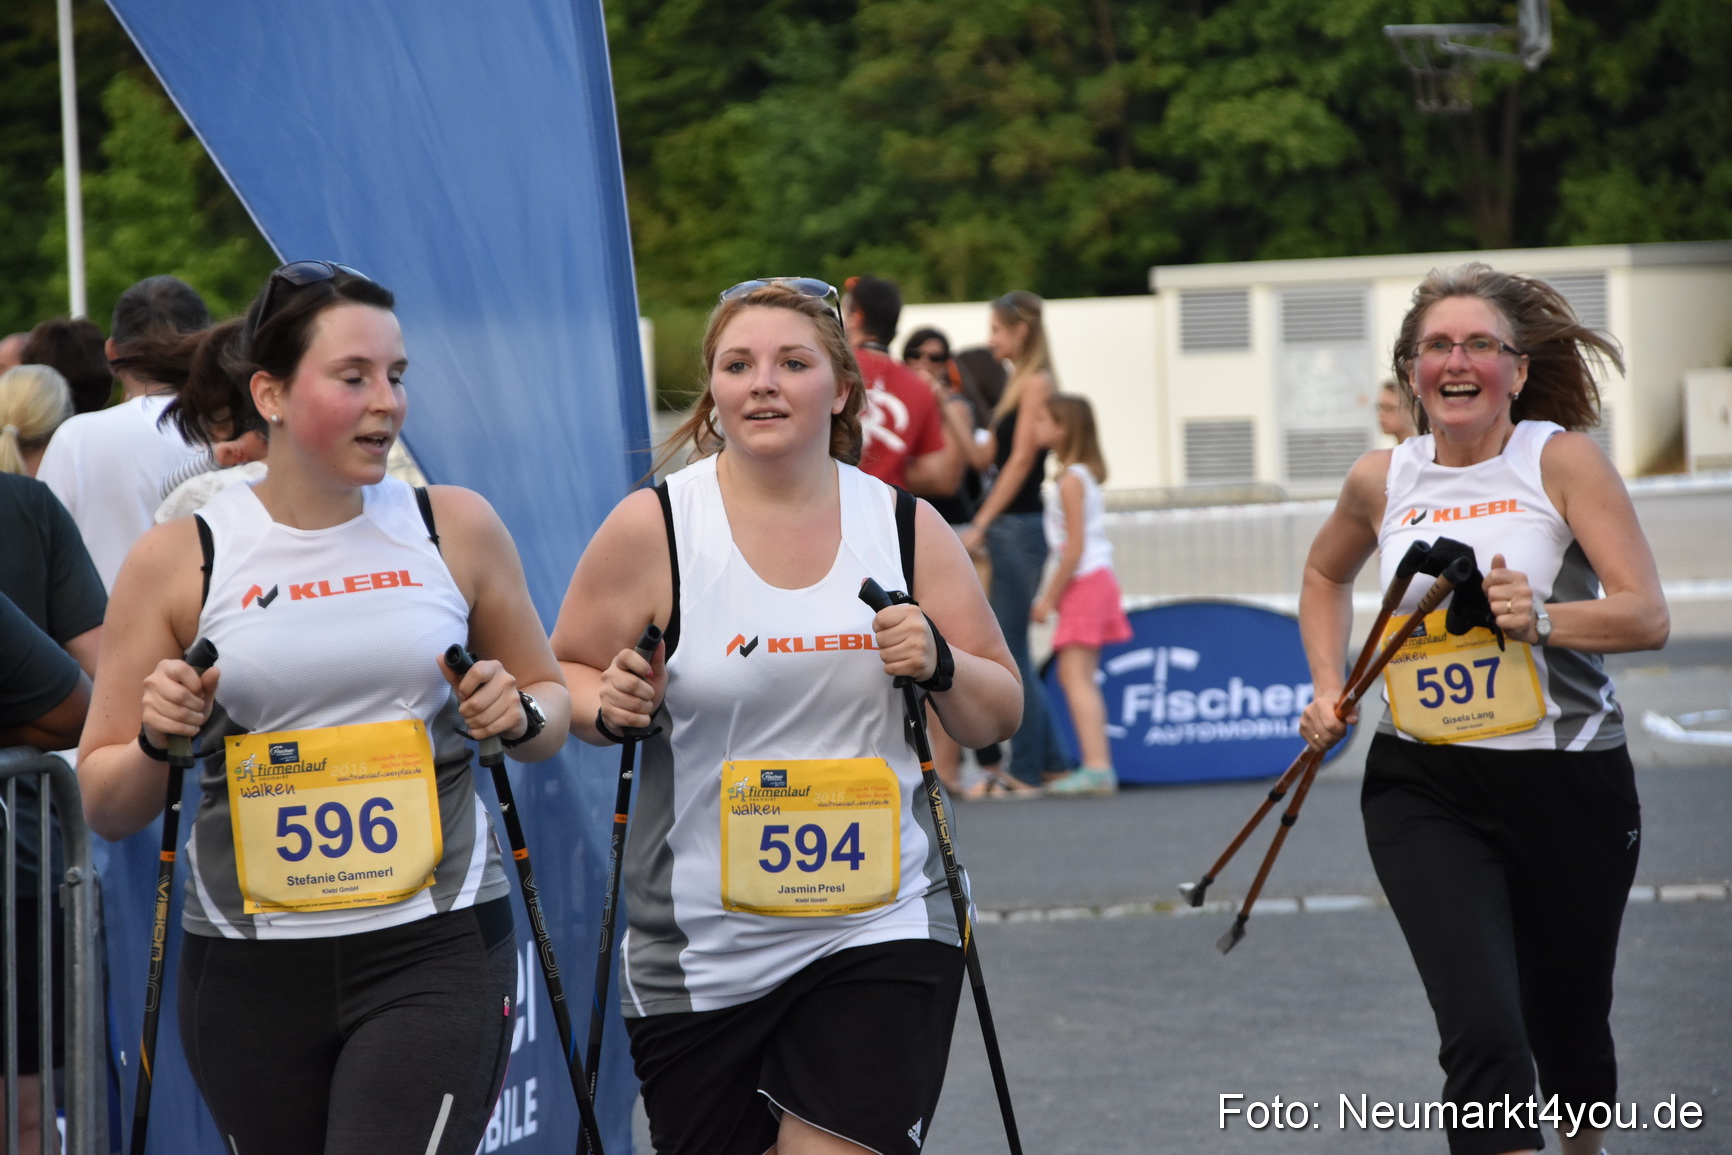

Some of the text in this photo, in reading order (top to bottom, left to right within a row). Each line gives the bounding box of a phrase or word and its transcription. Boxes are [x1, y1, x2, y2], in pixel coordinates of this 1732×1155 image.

[1433, 499, 1526, 523] KLEBL
[288, 569, 423, 601] KLEBL
[767, 633, 881, 653] KLEBL
[1416, 656, 1501, 709] 597
[1121, 676, 1314, 727] Fischer
[1442, 710, 1495, 725] Gisela Lang
[257, 757, 328, 776] firmenlauf
[240, 783, 296, 799] walken
[749, 785, 811, 798] firmenlauf
[731, 803, 781, 816] walken
[275, 796, 398, 862] 596
[758, 822, 866, 874] 594
[287, 867, 394, 886] Stefanie Gammerl
[339, 885, 359, 893] GmbH
[777, 883, 845, 895] Jasmin Presl
